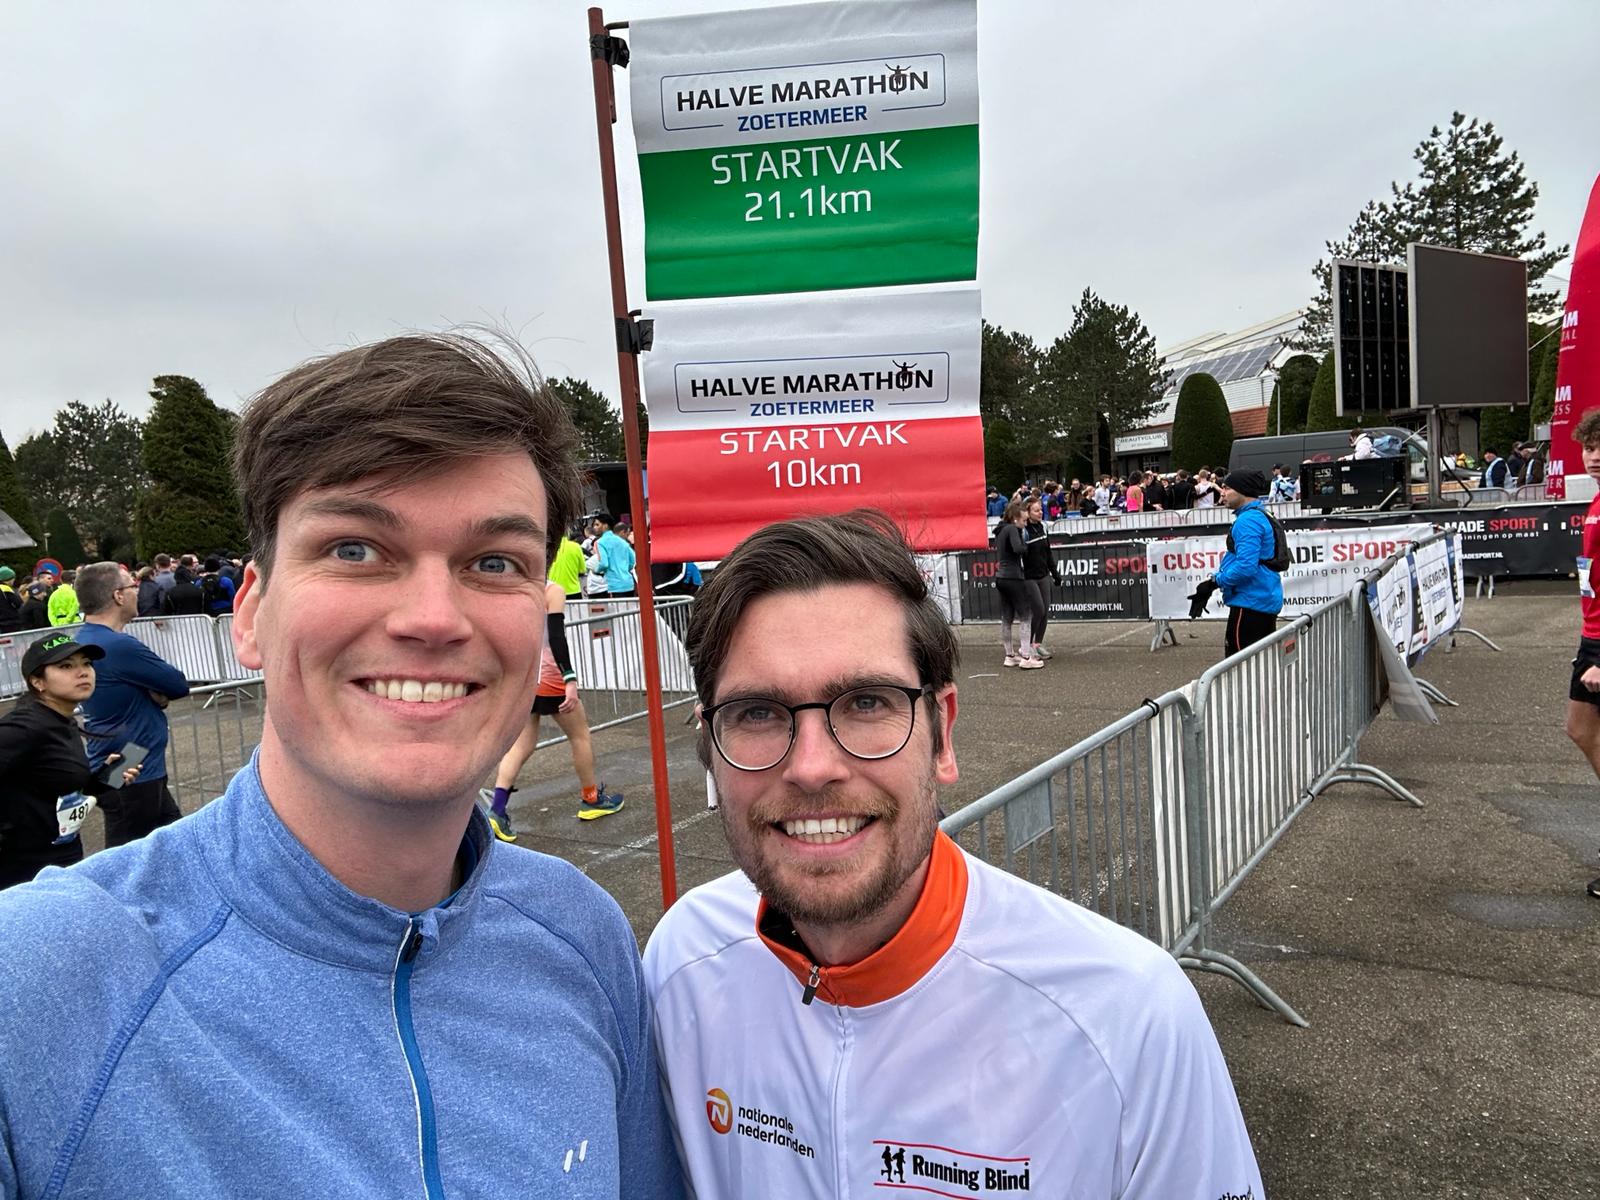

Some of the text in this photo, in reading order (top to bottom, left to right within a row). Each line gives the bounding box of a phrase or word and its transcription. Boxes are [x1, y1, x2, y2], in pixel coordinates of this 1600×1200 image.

[677, 70, 929, 111] HALVE MARATHON
[737, 105, 868, 132] ZOETERMEER
[711, 139, 903, 185] STARTVAK
[745, 185, 872, 222] 21.1km
[690, 369, 933, 398] HALVE MARATHON
[750, 398, 875, 416] ZOETERMEER
[720, 422, 909, 455] STARTVAK
[767, 458, 861, 488] 10km
[1489, 516, 1538, 530] SPORT
[1502, 532, 1513, 540] op
[1121, 578, 1135, 588] op
[738, 1105, 794, 1134] nationale
[738, 1123, 815, 1159] nederlanden
[912, 1154, 1030, 1192] Running Blind
